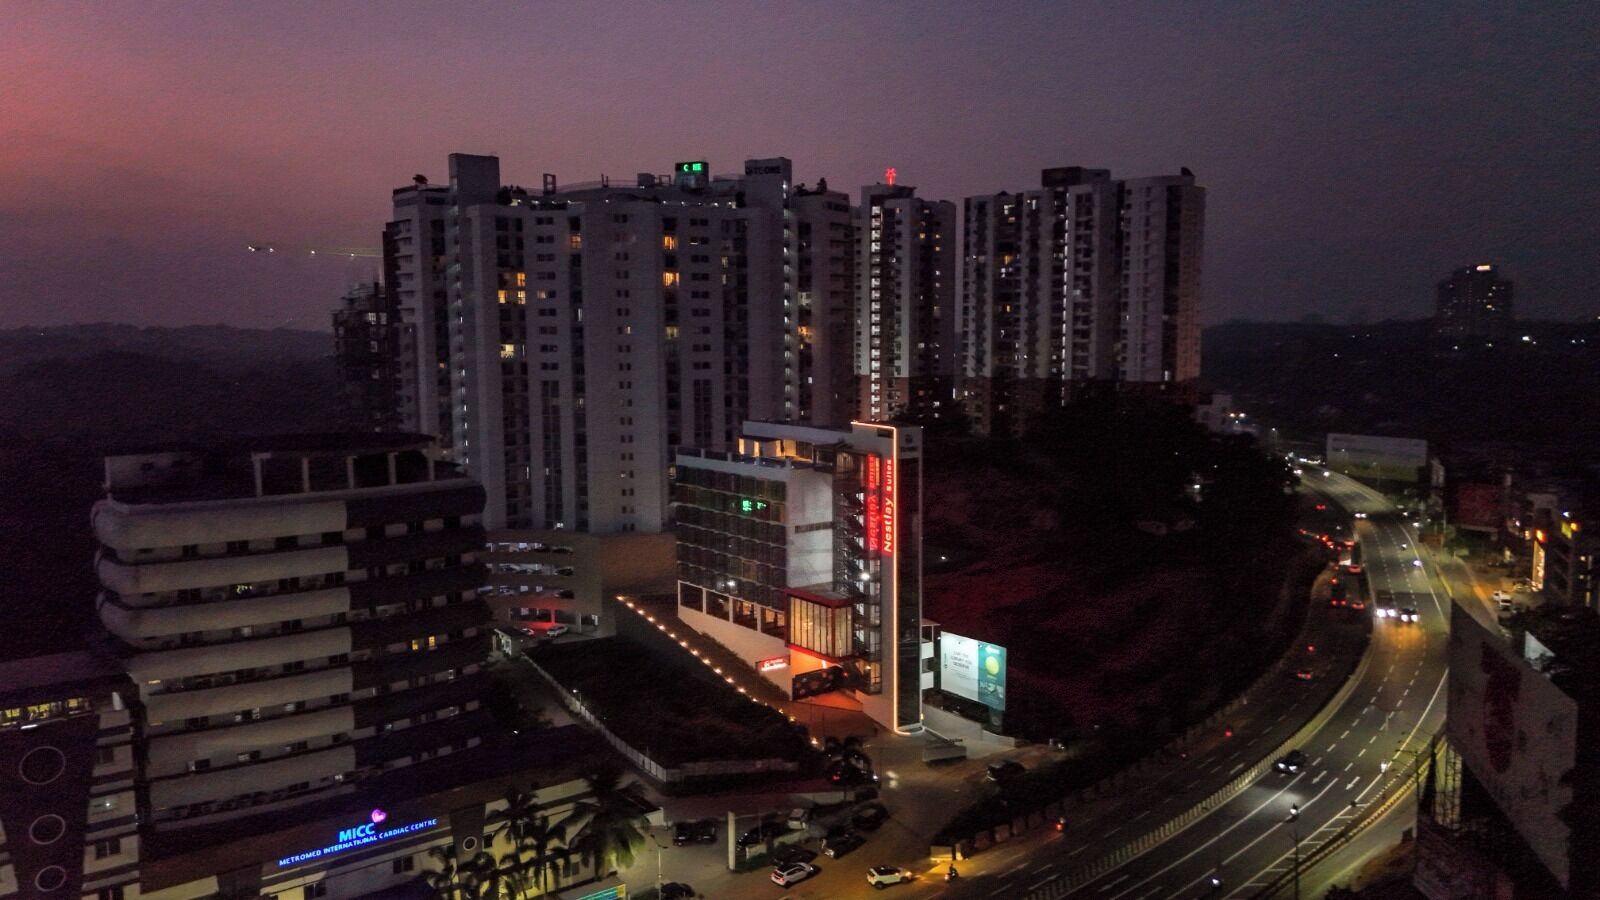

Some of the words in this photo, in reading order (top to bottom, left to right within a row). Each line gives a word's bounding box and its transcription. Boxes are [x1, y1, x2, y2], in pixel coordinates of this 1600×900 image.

[884, 497, 894, 552] Nestlay
[279, 850, 321, 866] METROMED
[323, 835, 377, 853] INTERNATIONAL
[379, 826, 409, 839] CARDIAC
[411, 819, 437, 830] CENTRE
[339, 823, 376, 842] MICC
